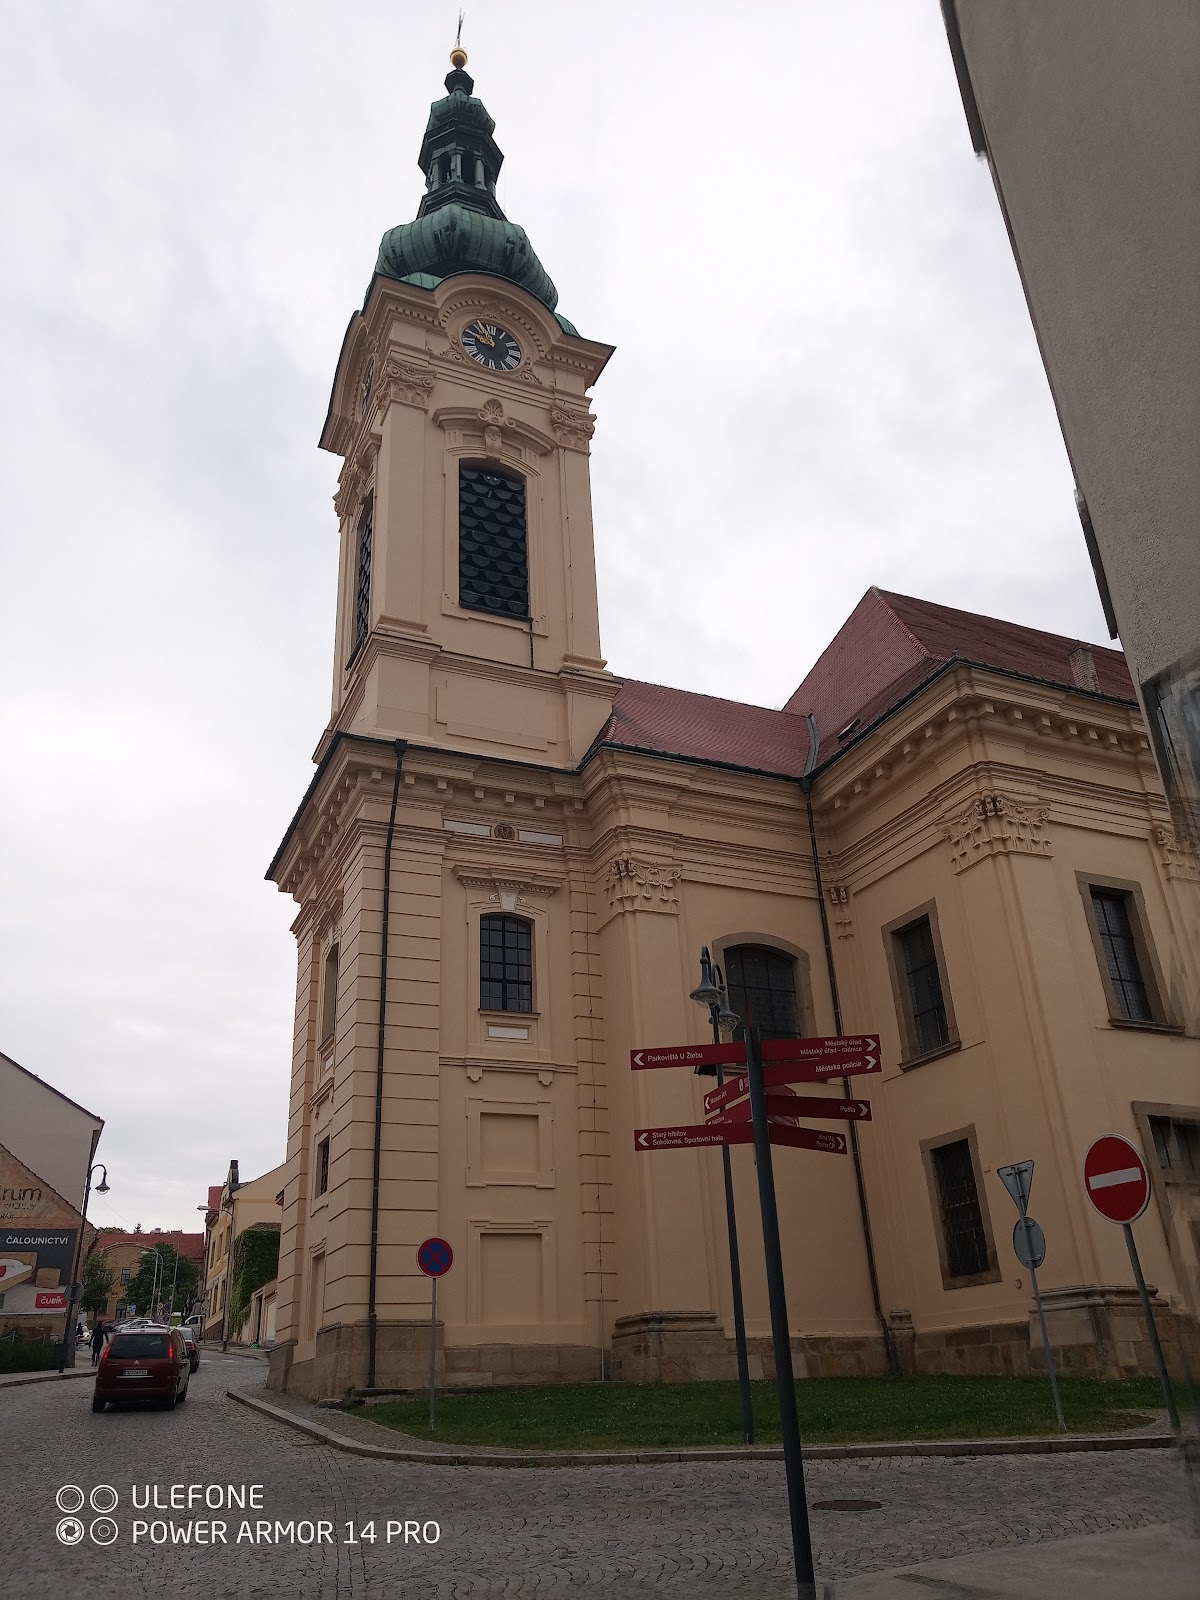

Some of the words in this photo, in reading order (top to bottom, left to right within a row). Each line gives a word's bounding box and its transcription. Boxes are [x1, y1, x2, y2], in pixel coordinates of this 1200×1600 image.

[647, 1053, 679, 1062] Parkoviště
[686, 1051, 703, 1059] Žlebu
[815, 1063, 841, 1072] Městská
[842, 1061, 862, 1070] policie
[840, 1105, 856, 1113] Pošta
[652, 1131, 667, 1139] Starý
[684, 1136, 711, 1144] Sportovní
[0, 1188, 42, 1201] rum
[6, 1235, 69, 1245] ČALOUNICTVÍ
